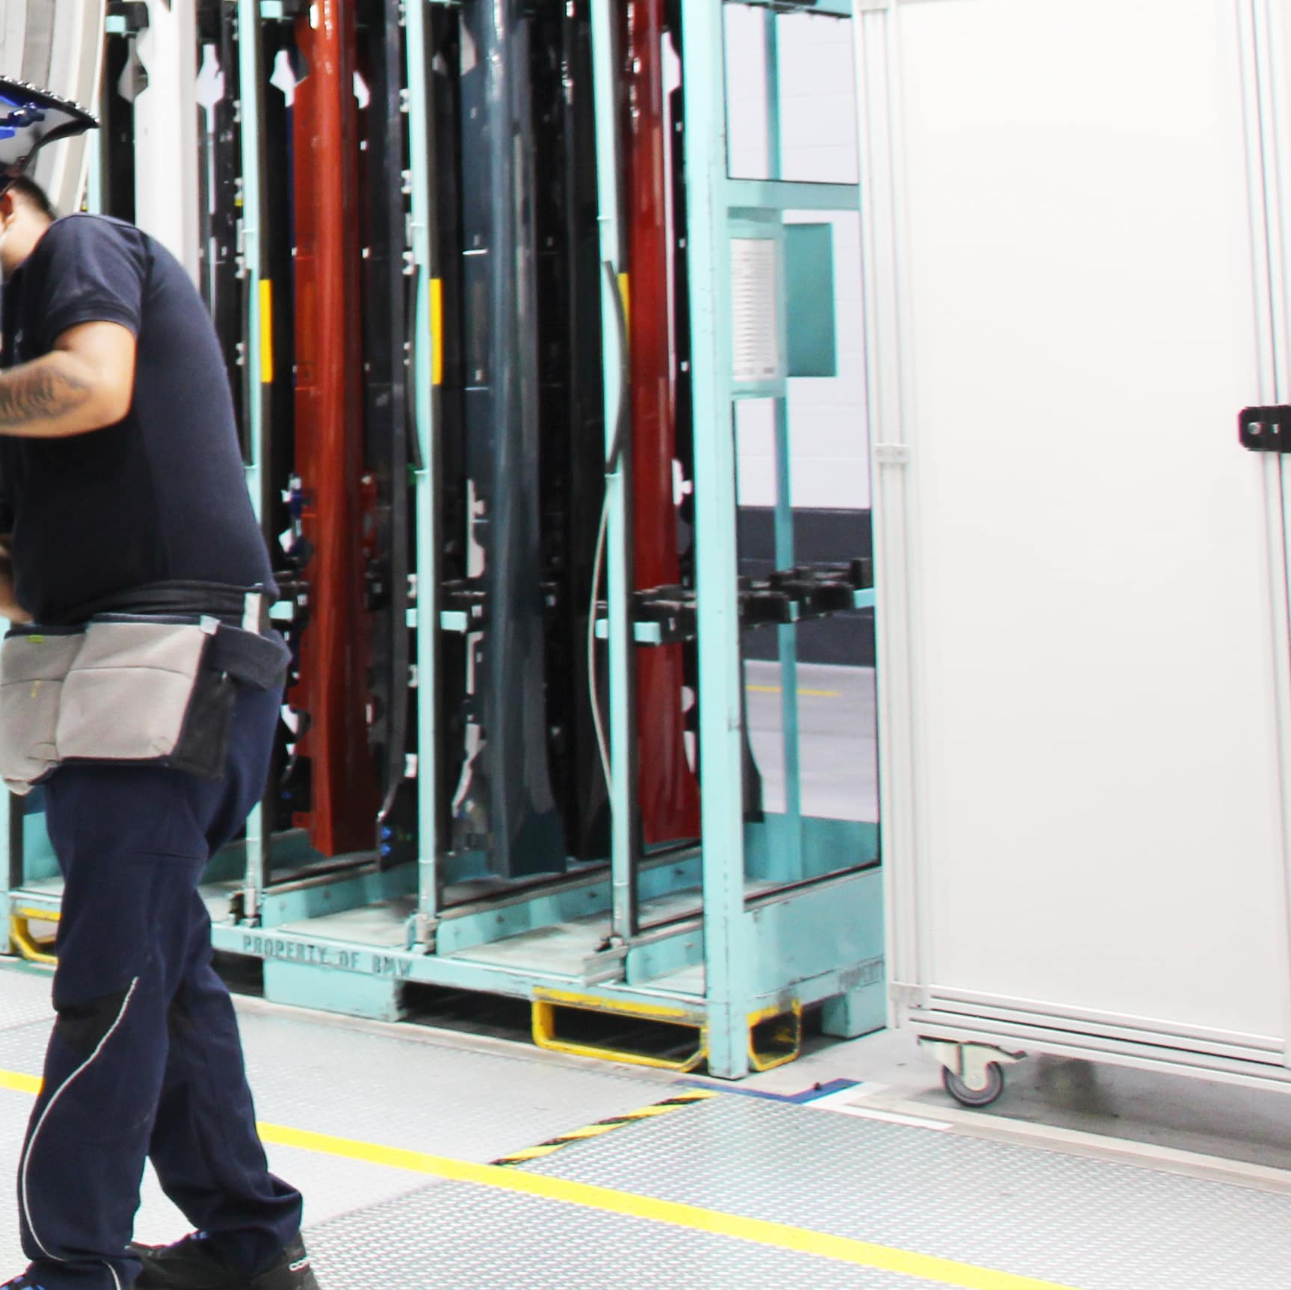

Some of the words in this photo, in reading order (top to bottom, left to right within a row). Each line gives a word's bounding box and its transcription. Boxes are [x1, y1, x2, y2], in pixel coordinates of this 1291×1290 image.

[242, 934, 329, 965] PROPERTY
[339, 950, 360, 969] OF
[371, 954, 413, 977] BMW
